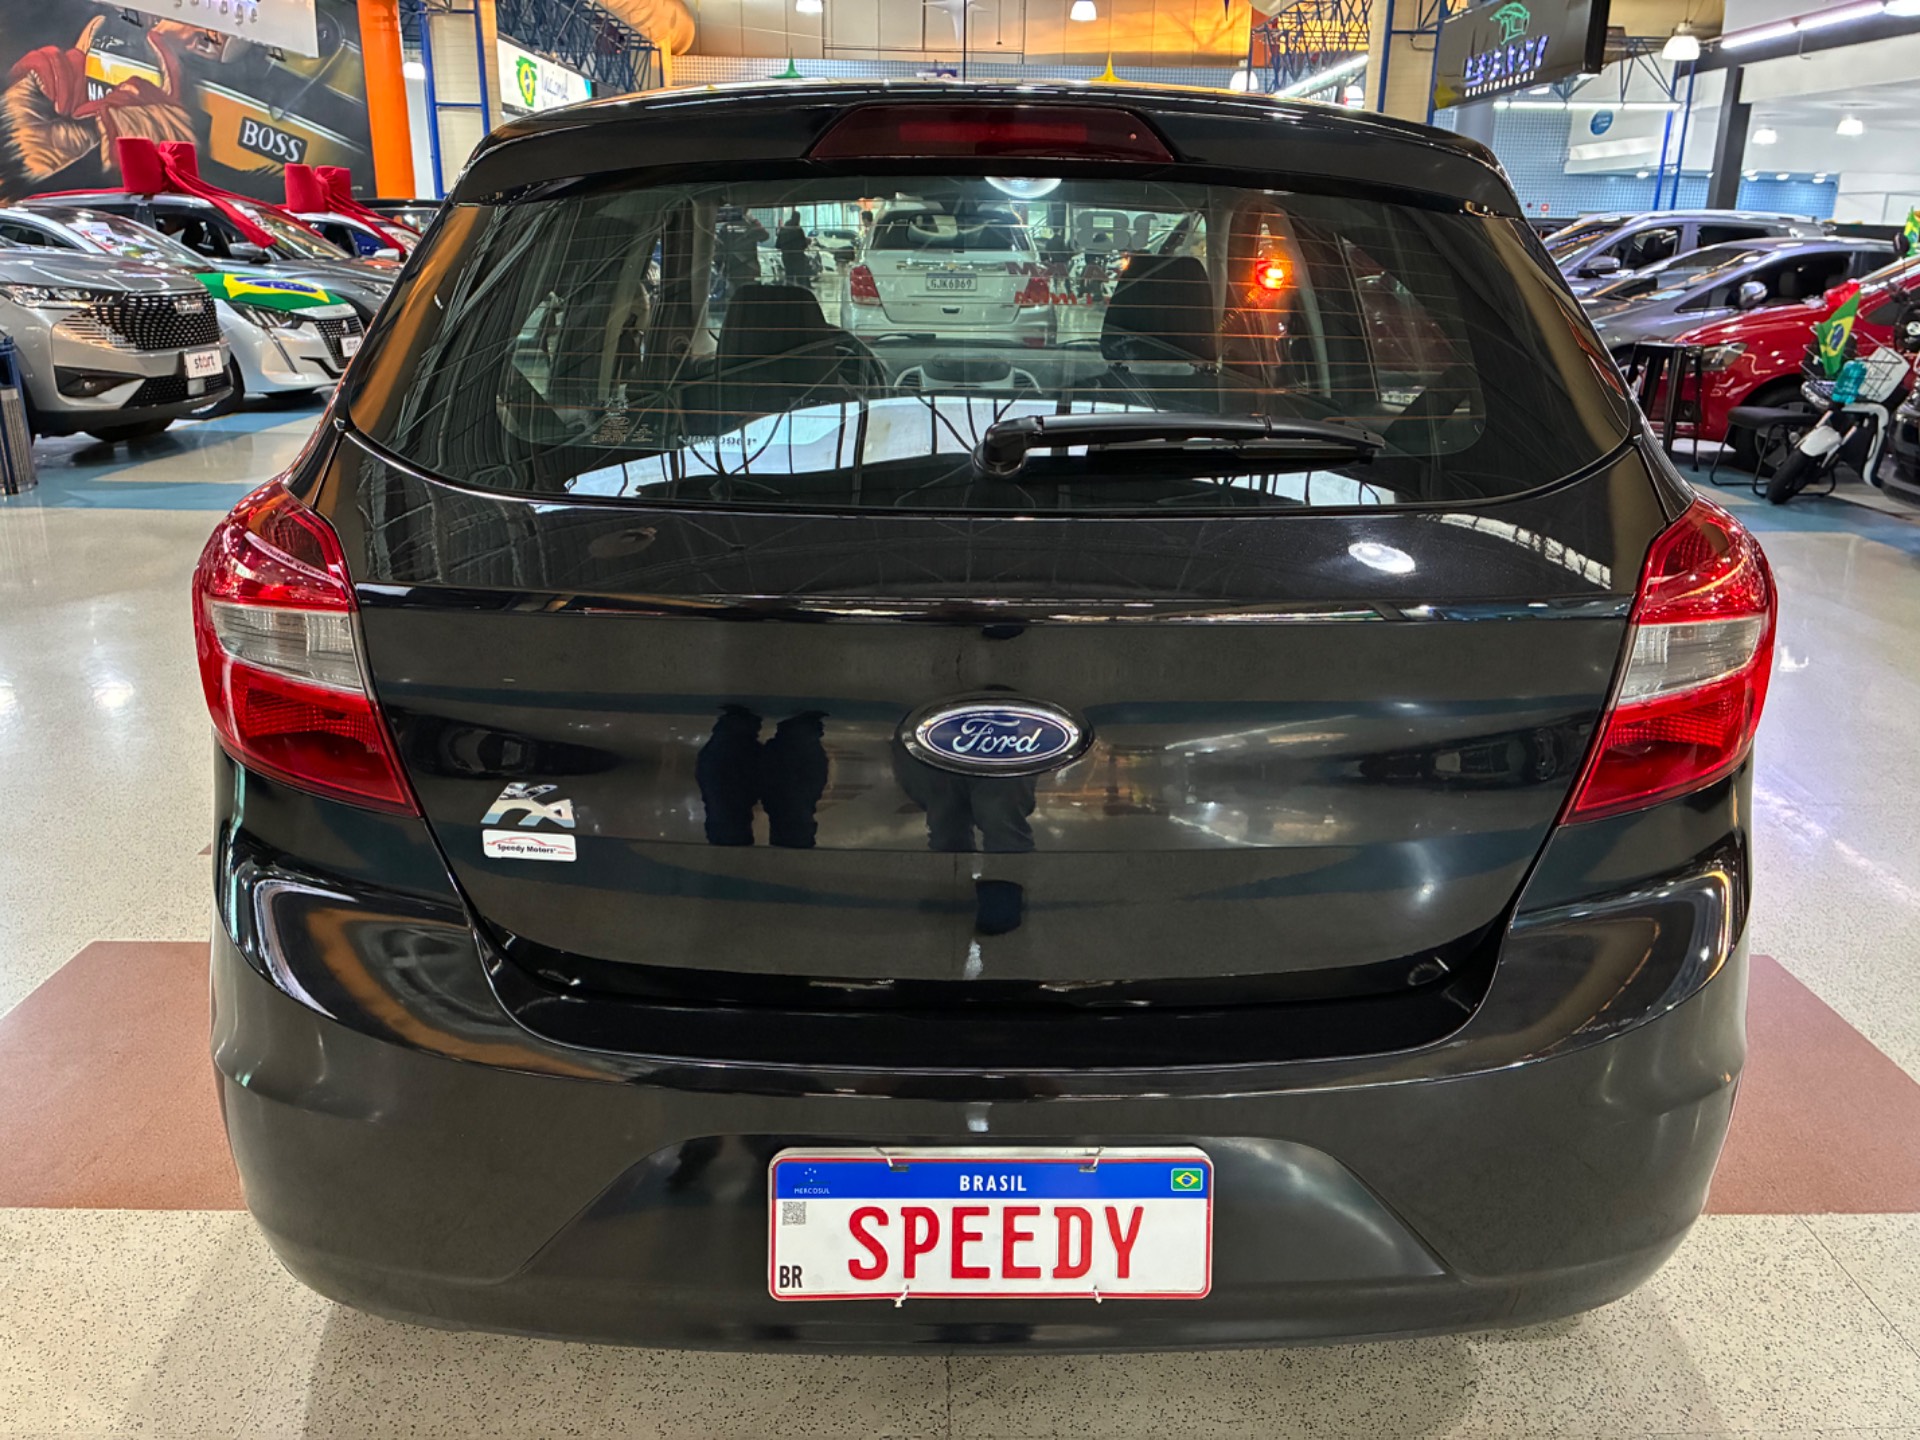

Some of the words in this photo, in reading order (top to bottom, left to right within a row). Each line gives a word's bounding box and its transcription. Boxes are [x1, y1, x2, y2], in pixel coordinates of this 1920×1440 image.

[242, 120, 302, 162] BOSS
[953, 718, 1043, 753] Ford
[497, 843, 525, 853] Speedy
[794, 1187, 830, 1195] MERCOSUL
[959, 1175, 1027, 1192] BRASIL
[848, 1206, 1144, 1280] SPEEDY
[779, 1265, 803, 1289] BR
